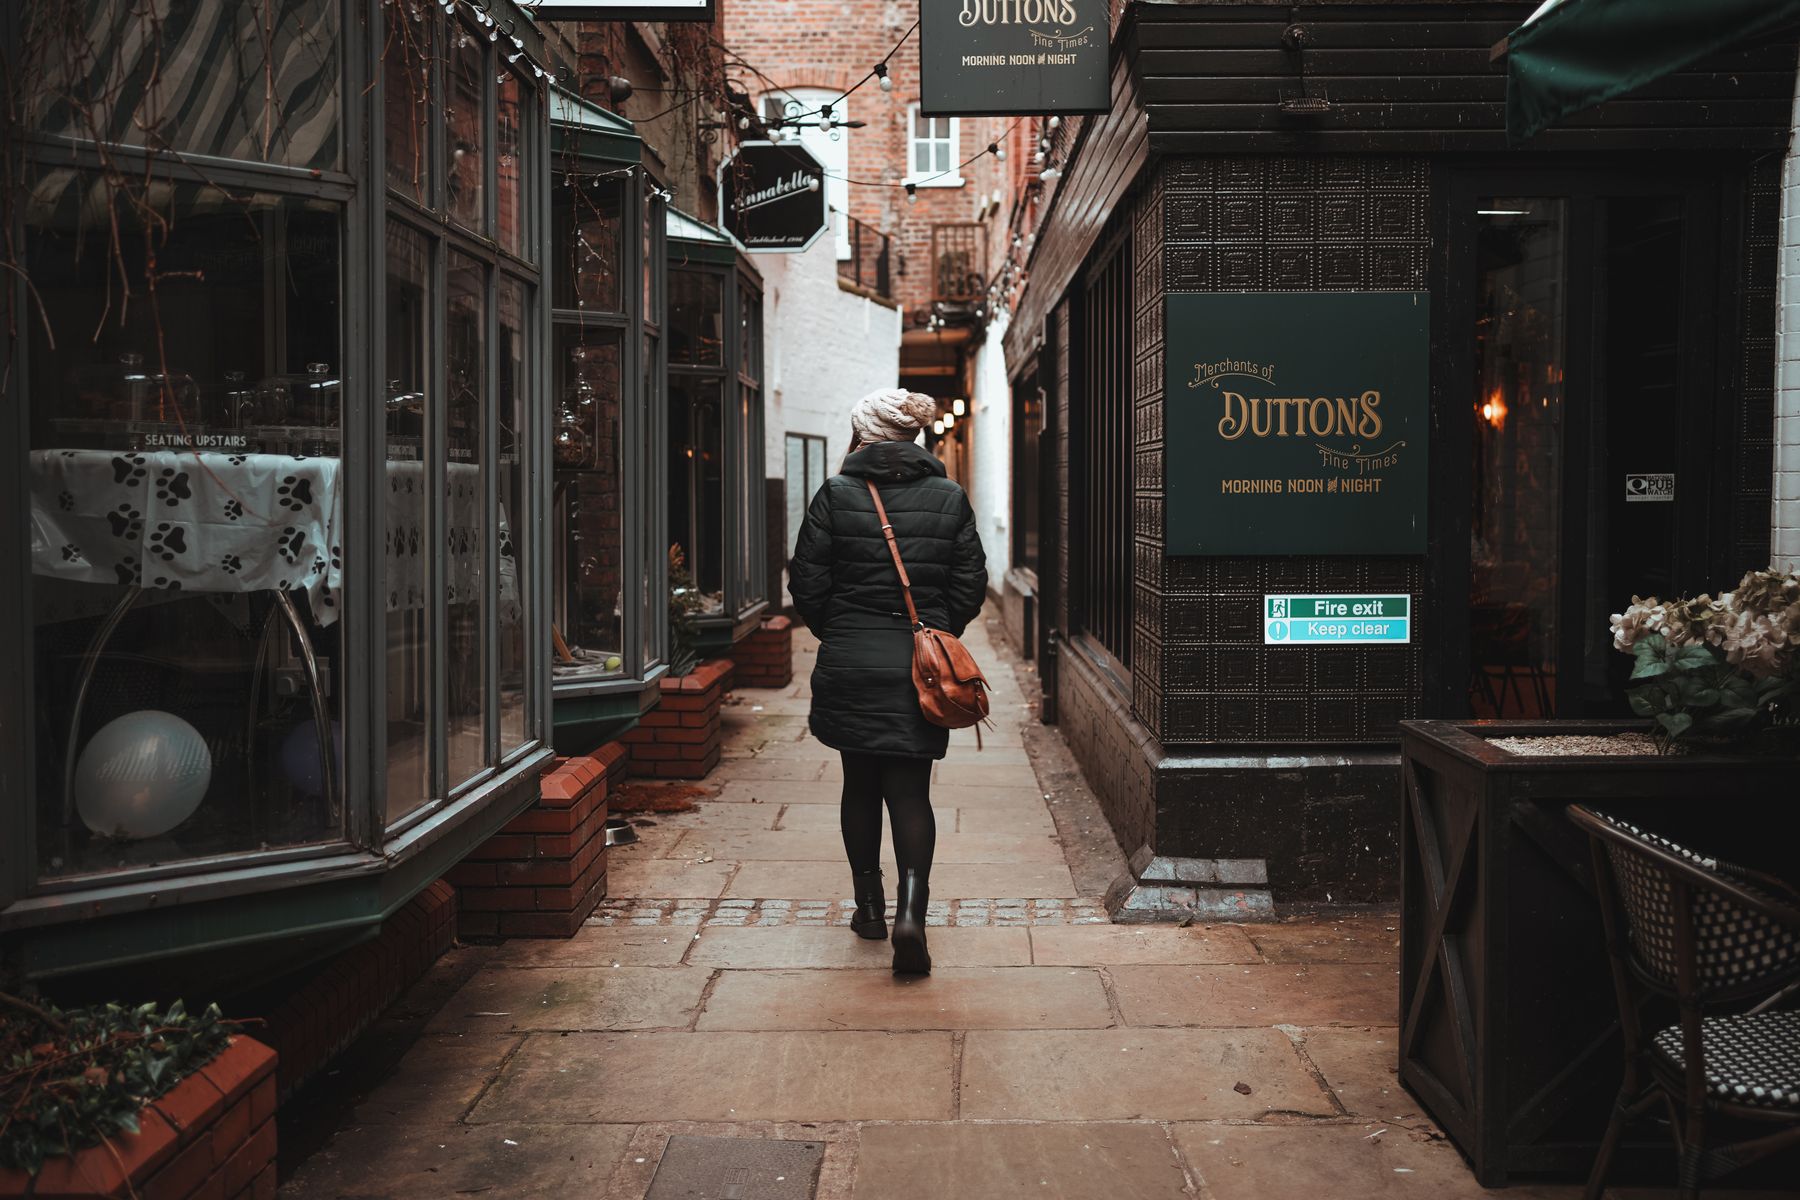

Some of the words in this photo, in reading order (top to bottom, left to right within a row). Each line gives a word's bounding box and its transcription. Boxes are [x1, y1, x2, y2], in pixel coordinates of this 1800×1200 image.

[959, 0, 1077, 27] DUTTONS
[1031, 33, 1053, 48] Fine
[1057, 35, 1088, 51] Times
[962, 55, 1006, 67] MORNING
[1009, 54, 1036, 65] NOON
[1047, 53, 1077, 65] NIGHT
[1194, 357, 1258, 382] Merchants
[1262, 364, 1275, 381] of
[1218, 391, 1383, 440] DUTTONS
[145, 434, 192, 446] SEATING
[196, 435, 247, 447] UPSTAIRS
[1319, 449, 1349, 470] Fine
[1356, 453, 1398, 475] Times
[1221, 479, 1282, 494] MORNING
[1288, 479, 1323, 493] NOON
[1341, 478, 1382, 493] NIGHT
[1648, 479, 1673, 490] PUB
[1314, 600, 1348, 616] Fire
[1352, 600, 1384, 615] exit
[1308, 622, 1347, 638] Keep
[1351, 622, 1390, 635] clear
